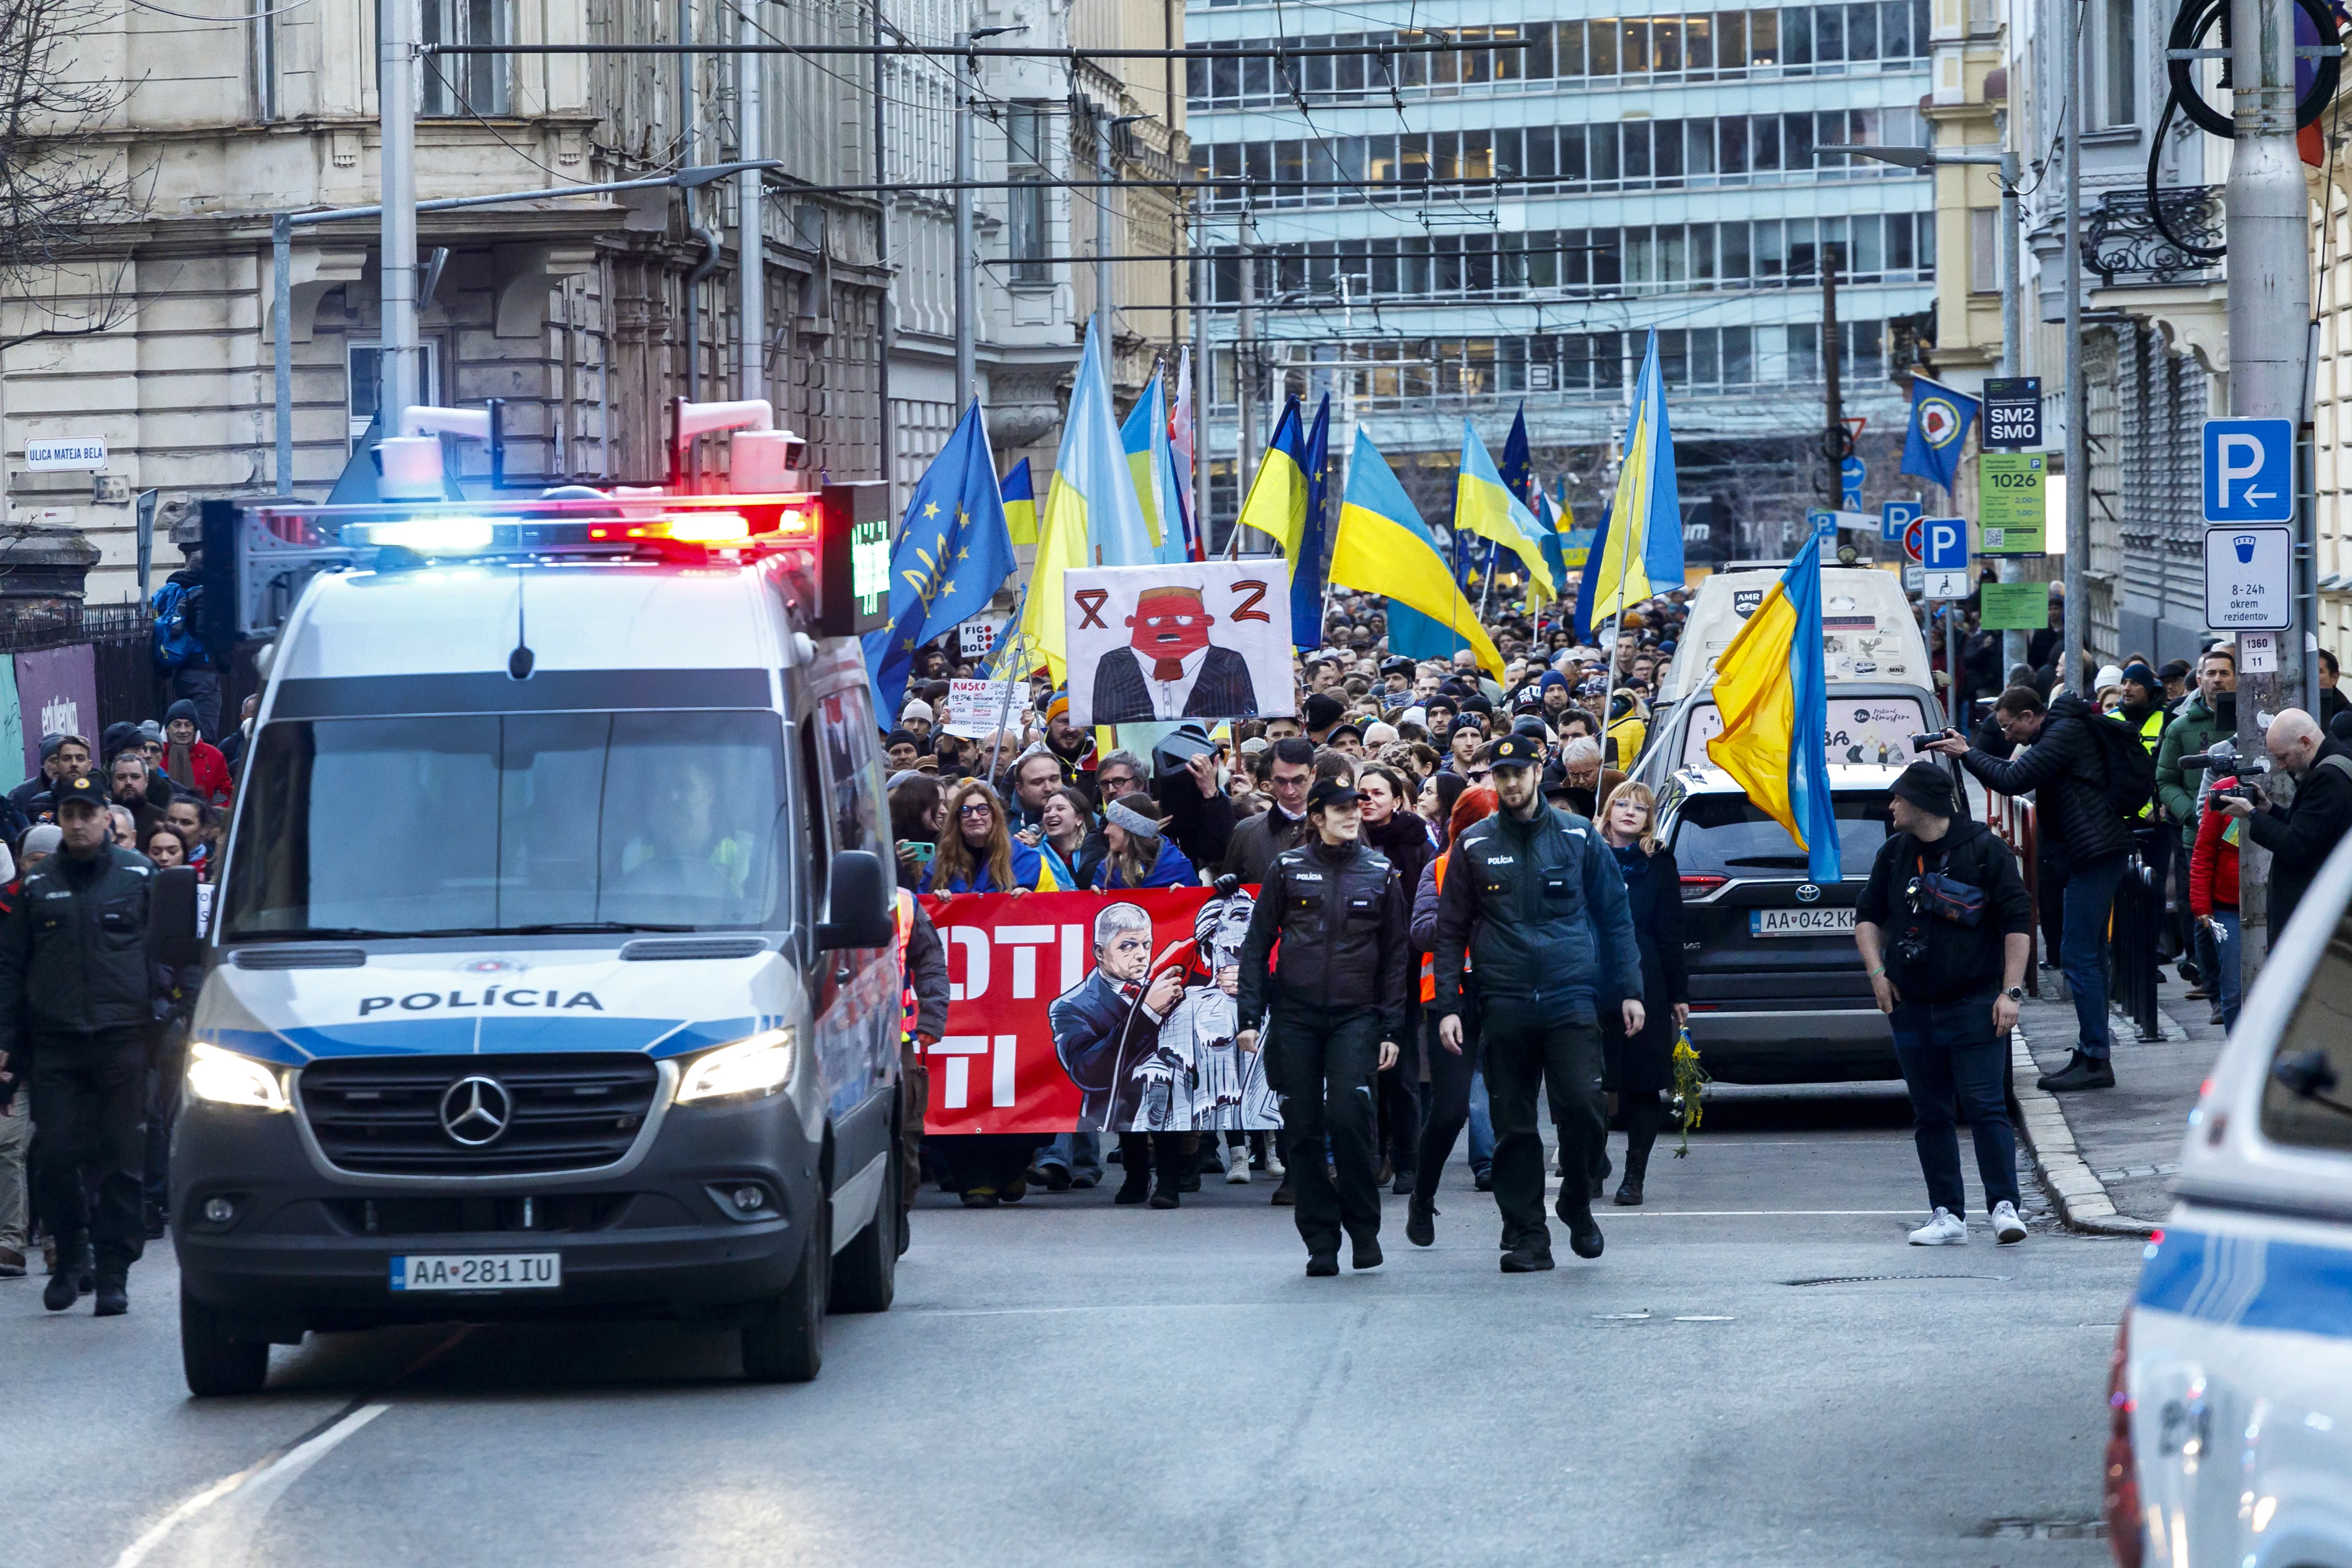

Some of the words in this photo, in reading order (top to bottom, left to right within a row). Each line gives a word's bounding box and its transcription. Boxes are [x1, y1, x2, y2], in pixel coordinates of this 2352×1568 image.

[1991, 407, 2035, 423] SM2
[29, 449, 52, 461] ULICA
[54, 448, 82, 460] MATEJA
[84, 447, 103, 459] BELA
[2219, 433, 2265, 508] P
[1991, 474, 2037, 488] 1026
[1890, 507, 1910, 535] P
[1932, 526, 1956, 563] P
[1737, 593, 1760, 601] AMR
[2230, 599, 2258, 609] okrem
[2224, 612, 2268, 621] rezidentov
[2247, 638, 2268, 649] 1360
[2251, 657, 2262, 666] 11
[953, 682, 986, 691] RUSKO
[1488, 855, 1514, 865] POLÍCIA
[1296, 871, 1323, 881] POLÍCIA
[911, 924, 1084, 1001] OTI
[358, 984, 604, 1016] POLÍCIA
[913, 1035, 1016, 1109] TI
